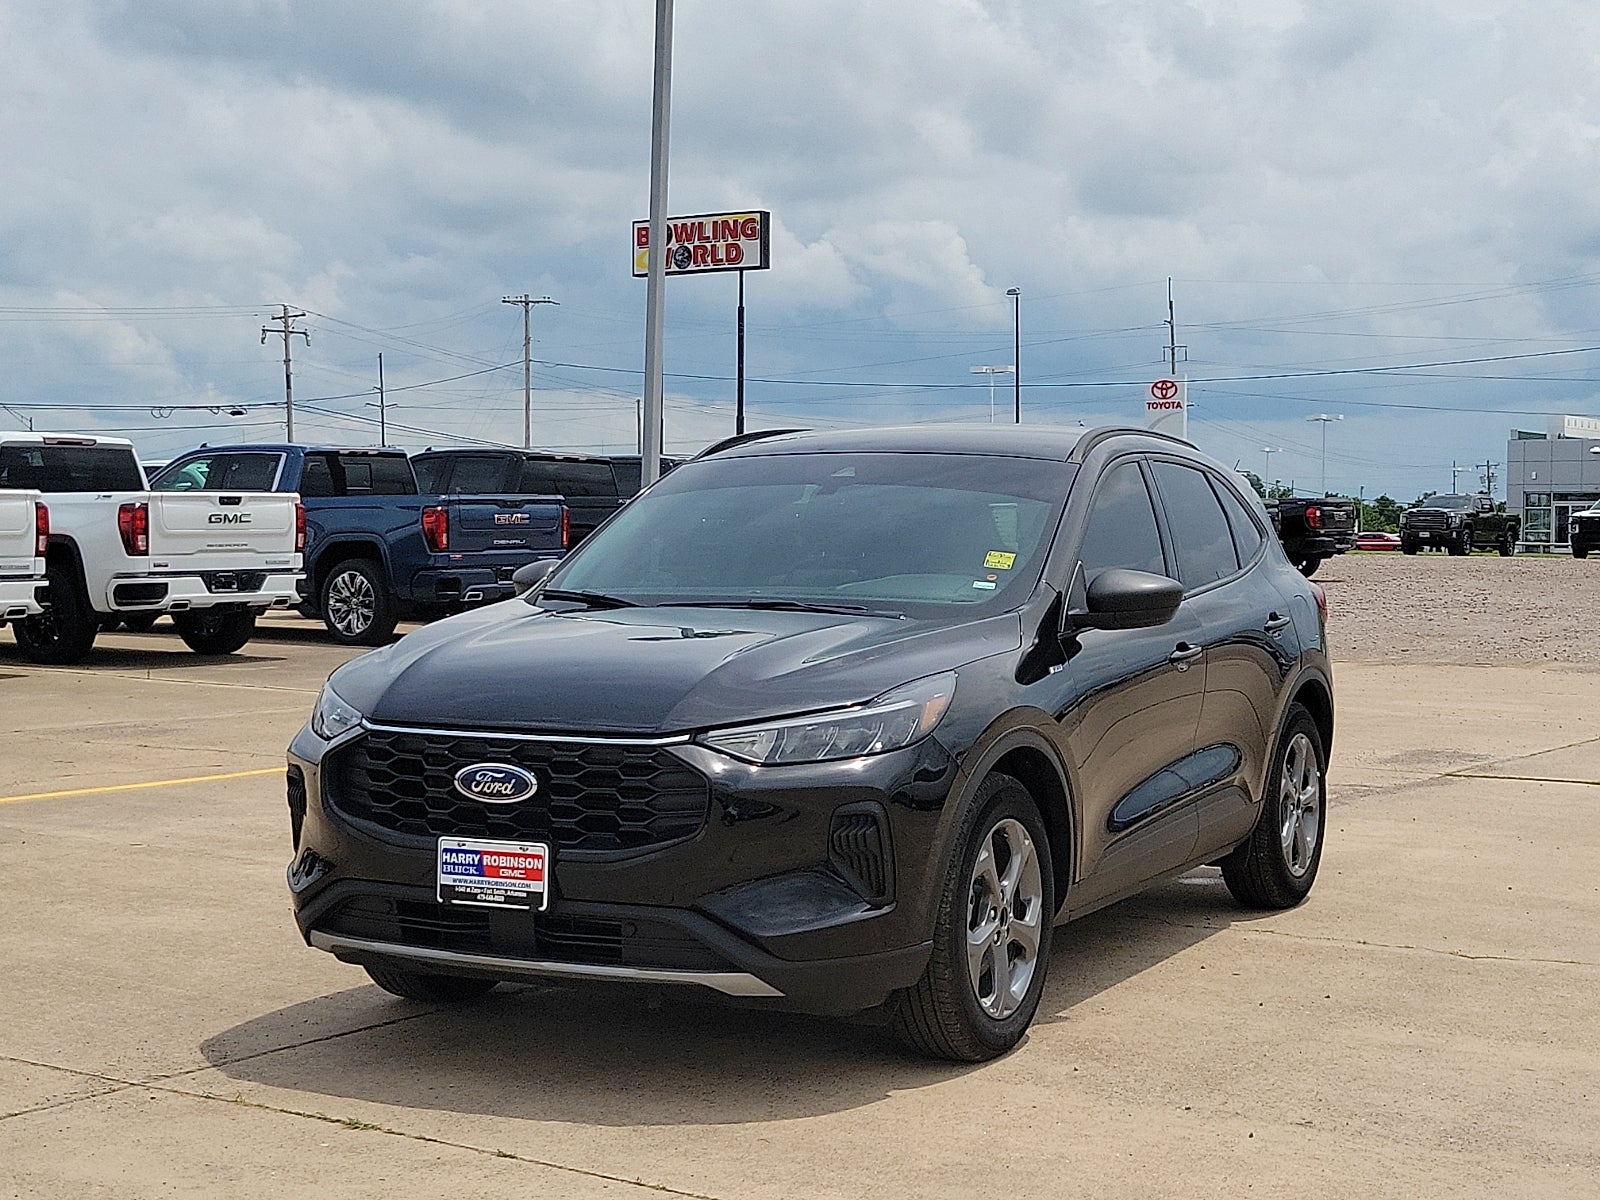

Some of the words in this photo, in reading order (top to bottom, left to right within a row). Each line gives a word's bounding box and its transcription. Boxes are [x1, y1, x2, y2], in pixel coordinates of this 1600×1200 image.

[1146, 401, 1183, 410] TOYOTA
[208, 513, 252, 524] GMC
[494, 513, 531, 525] GMC
[471, 770, 517, 795] Ford
[442, 851, 481, 866] HARRY
[483, 854, 543, 870] ROBINSON
[442, 864, 479, 875] BUICK
[499, 869, 527, 878] GMC
